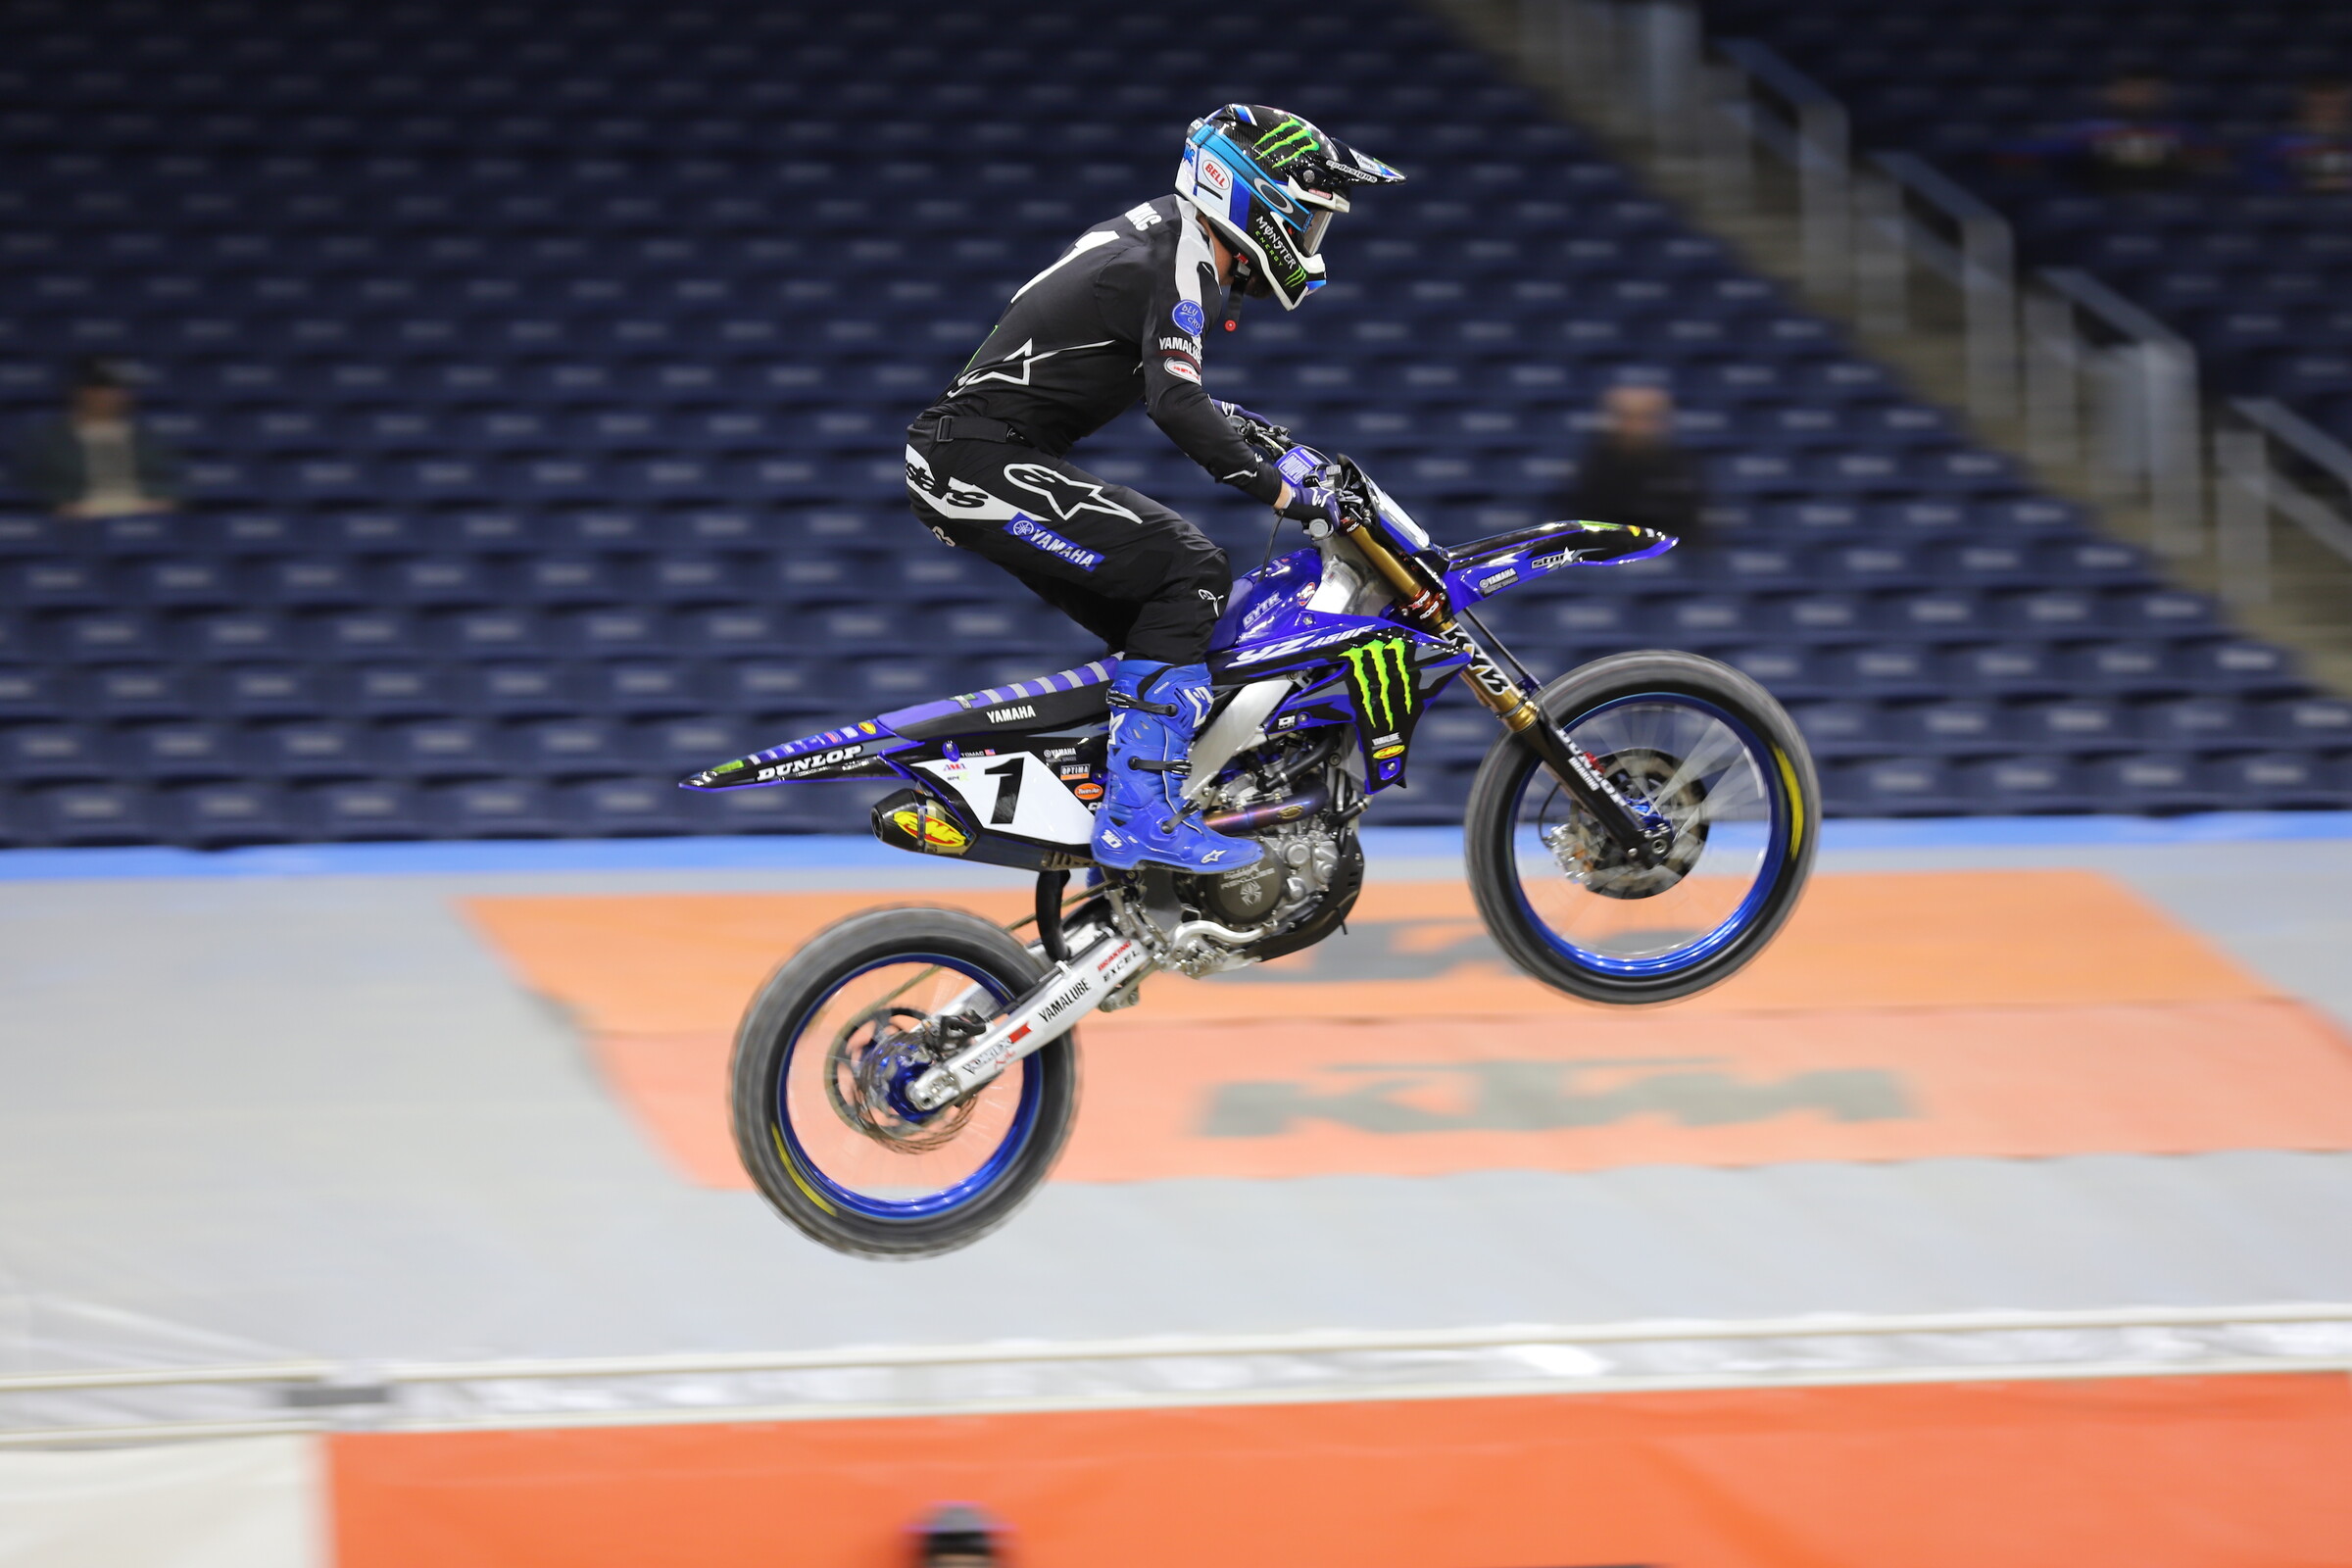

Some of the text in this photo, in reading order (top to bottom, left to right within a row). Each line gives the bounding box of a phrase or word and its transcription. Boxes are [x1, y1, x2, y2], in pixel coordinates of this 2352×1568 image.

[1204, 163, 1225, 187] BELL
[1254, 230, 1284, 267] ENERGY
[1255, 215, 1297, 270] MONSTER
[1030, 528, 1096, 568] YAMAHA
[1487, 567, 1517, 585] YAMAHA
[1243, 591, 1280, 625] GYTR
[1304, 624, 1376, 648] 450F
[987, 705, 1037, 725] YAMAHA
[757, 745, 862, 781] DUNLOP
[1051, 747, 1077, 758] YAMAHA
[1061, 764, 1090, 775] OPTIMA
[1568, 756, 1600, 791] BRAKING
[984, 757, 1025, 825] 1
[1038, 978, 1092, 1023] YAMALUBE
